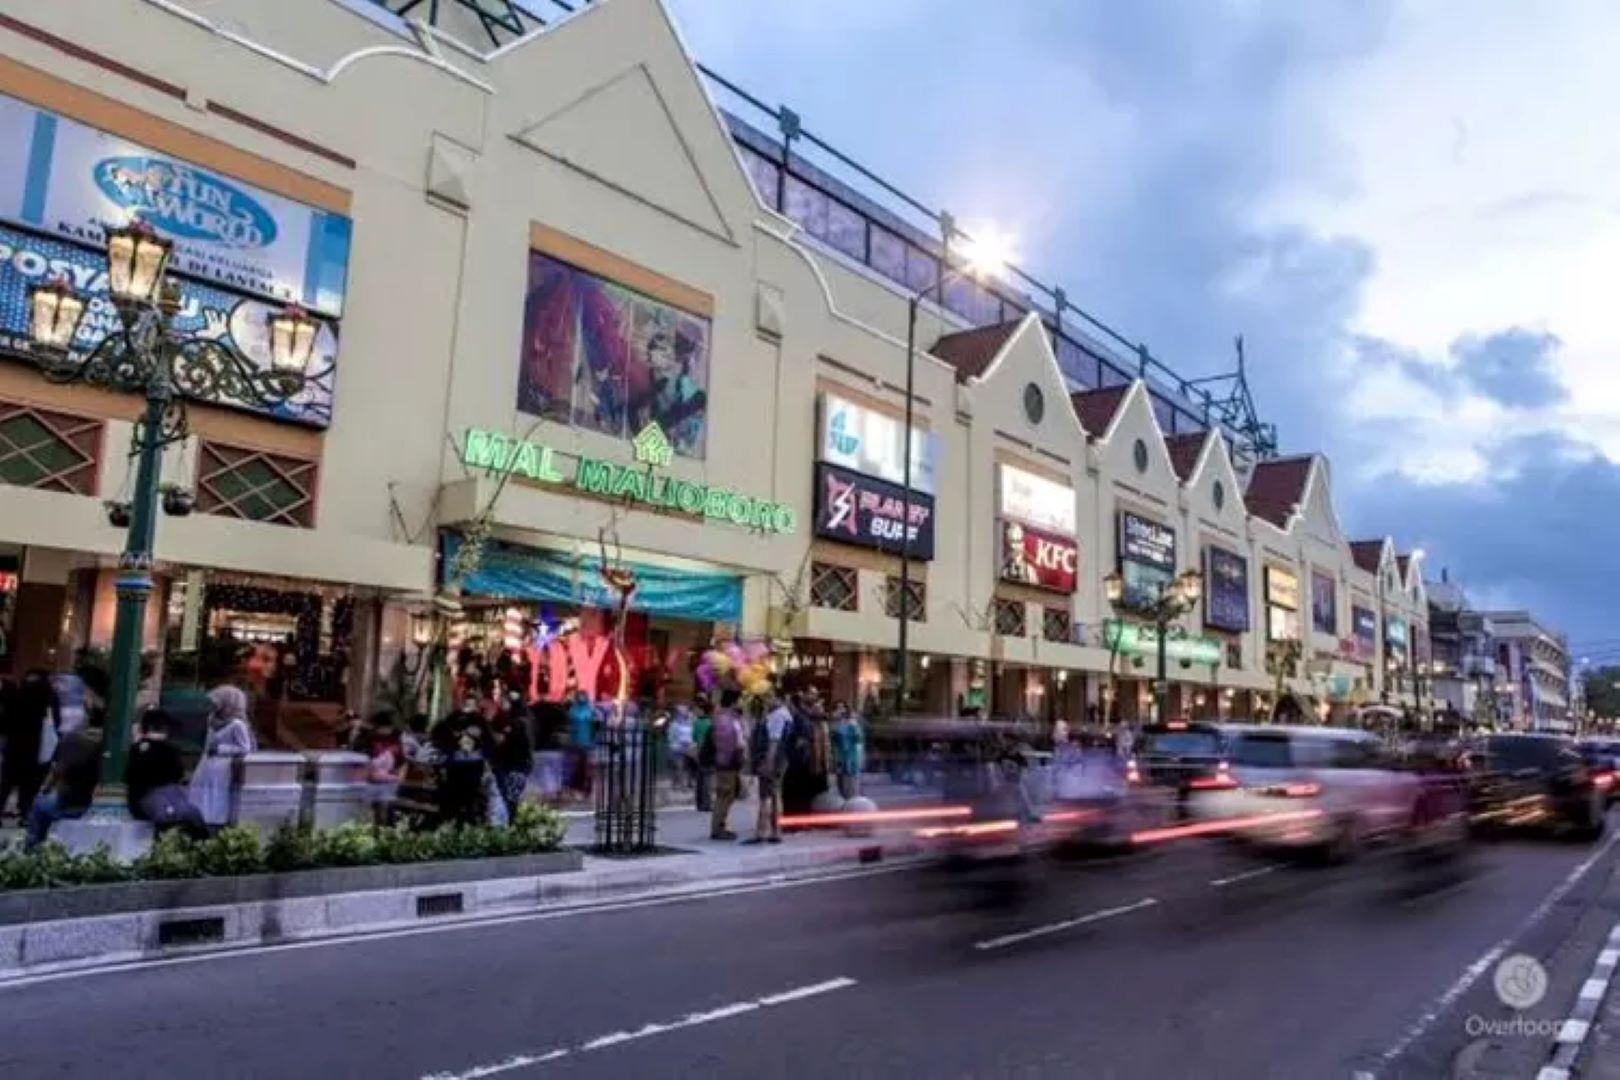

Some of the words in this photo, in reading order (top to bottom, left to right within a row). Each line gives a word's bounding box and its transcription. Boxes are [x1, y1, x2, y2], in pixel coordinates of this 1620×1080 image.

[465, 427, 563, 482] MAL
[576, 454, 797, 534] MALIOBORO
[1036, 538, 1076, 574] KFC
